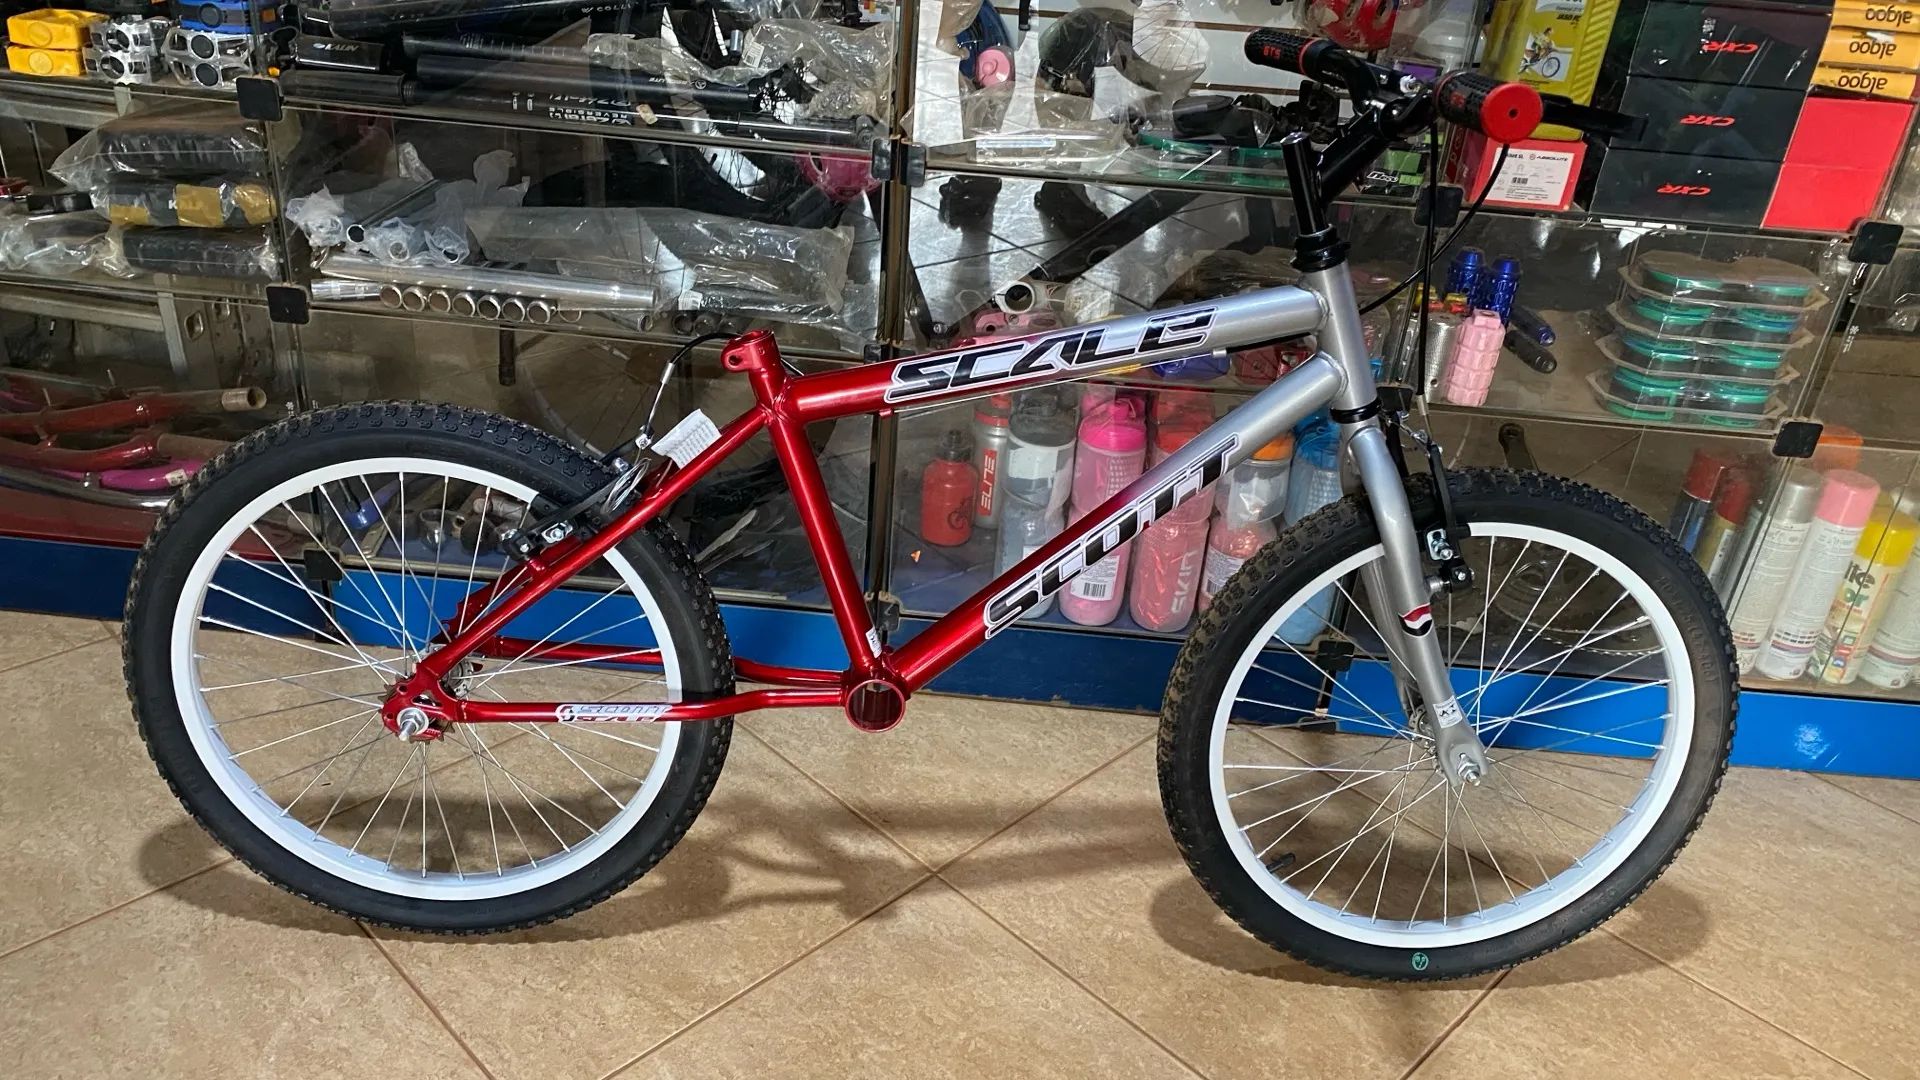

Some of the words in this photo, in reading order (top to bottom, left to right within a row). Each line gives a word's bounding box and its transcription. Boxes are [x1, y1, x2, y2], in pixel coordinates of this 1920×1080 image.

[1864, 4, 1914, 28] algoo
[1849, 37, 1898, 60] algoo
[1837, 71, 1889, 94] algoo
[1678, 113, 1736, 127] CXR
[1655, 182, 1712, 196] CXR
[885, 306, 1216, 402] SCALE
[981, 454, 995, 511] ELITE
[985, 433, 1238, 639] SCOTT
